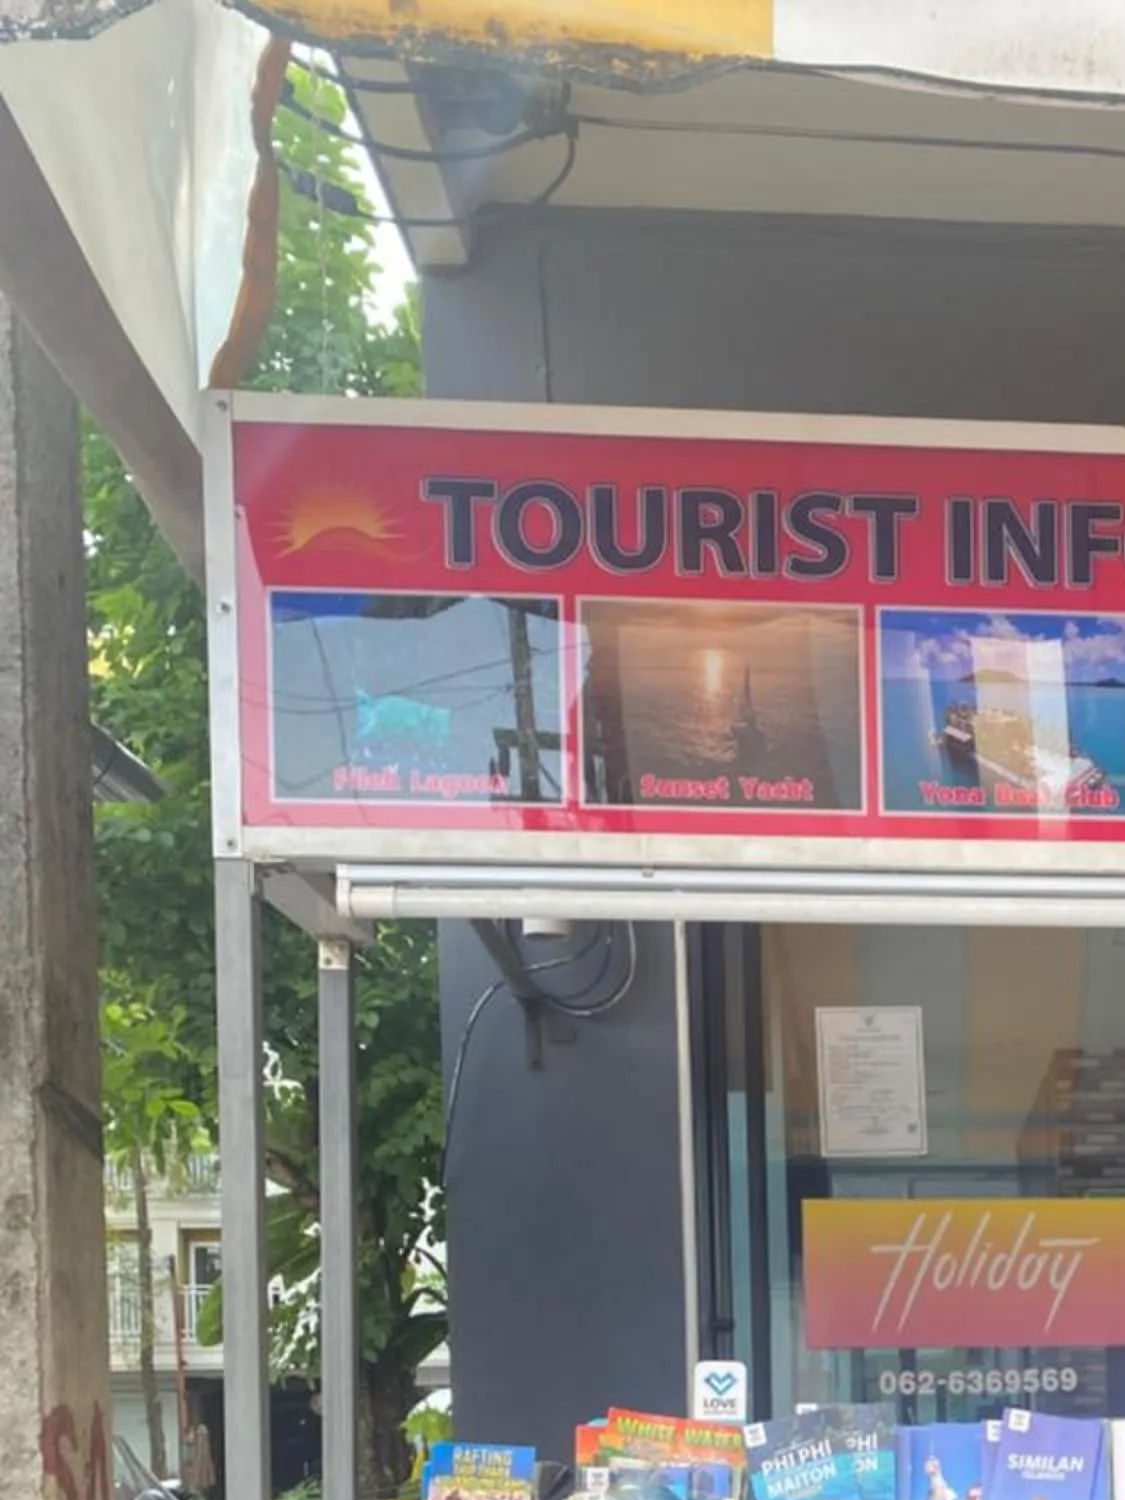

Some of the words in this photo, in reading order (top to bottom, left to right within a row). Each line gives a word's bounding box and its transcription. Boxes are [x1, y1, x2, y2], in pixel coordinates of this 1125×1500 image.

[420, 477, 918, 584] TOURIST
[640, 774, 730, 799] Sunset
[738, 776, 814, 801] Yacht
[919, 780, 986, 805] Yona
[1064, 782, 1120, 808] Club
[869, 1212, 1101, 1335] Holiday
[878, 1367, 1078, 1396] 062-6369569
[703, 1399, 737, 1410] LOVE
[616, 1416, 677, 1444] WHITE
[684, 1427, 743, 1449] WATER
[761, 1451, 796, 1477] PHI
[798, 1438, 833, 1464] PHI
[1007, 1452, 1085, 1473] SIMILAN
[766, 1460, 838, 1500] MAITON
